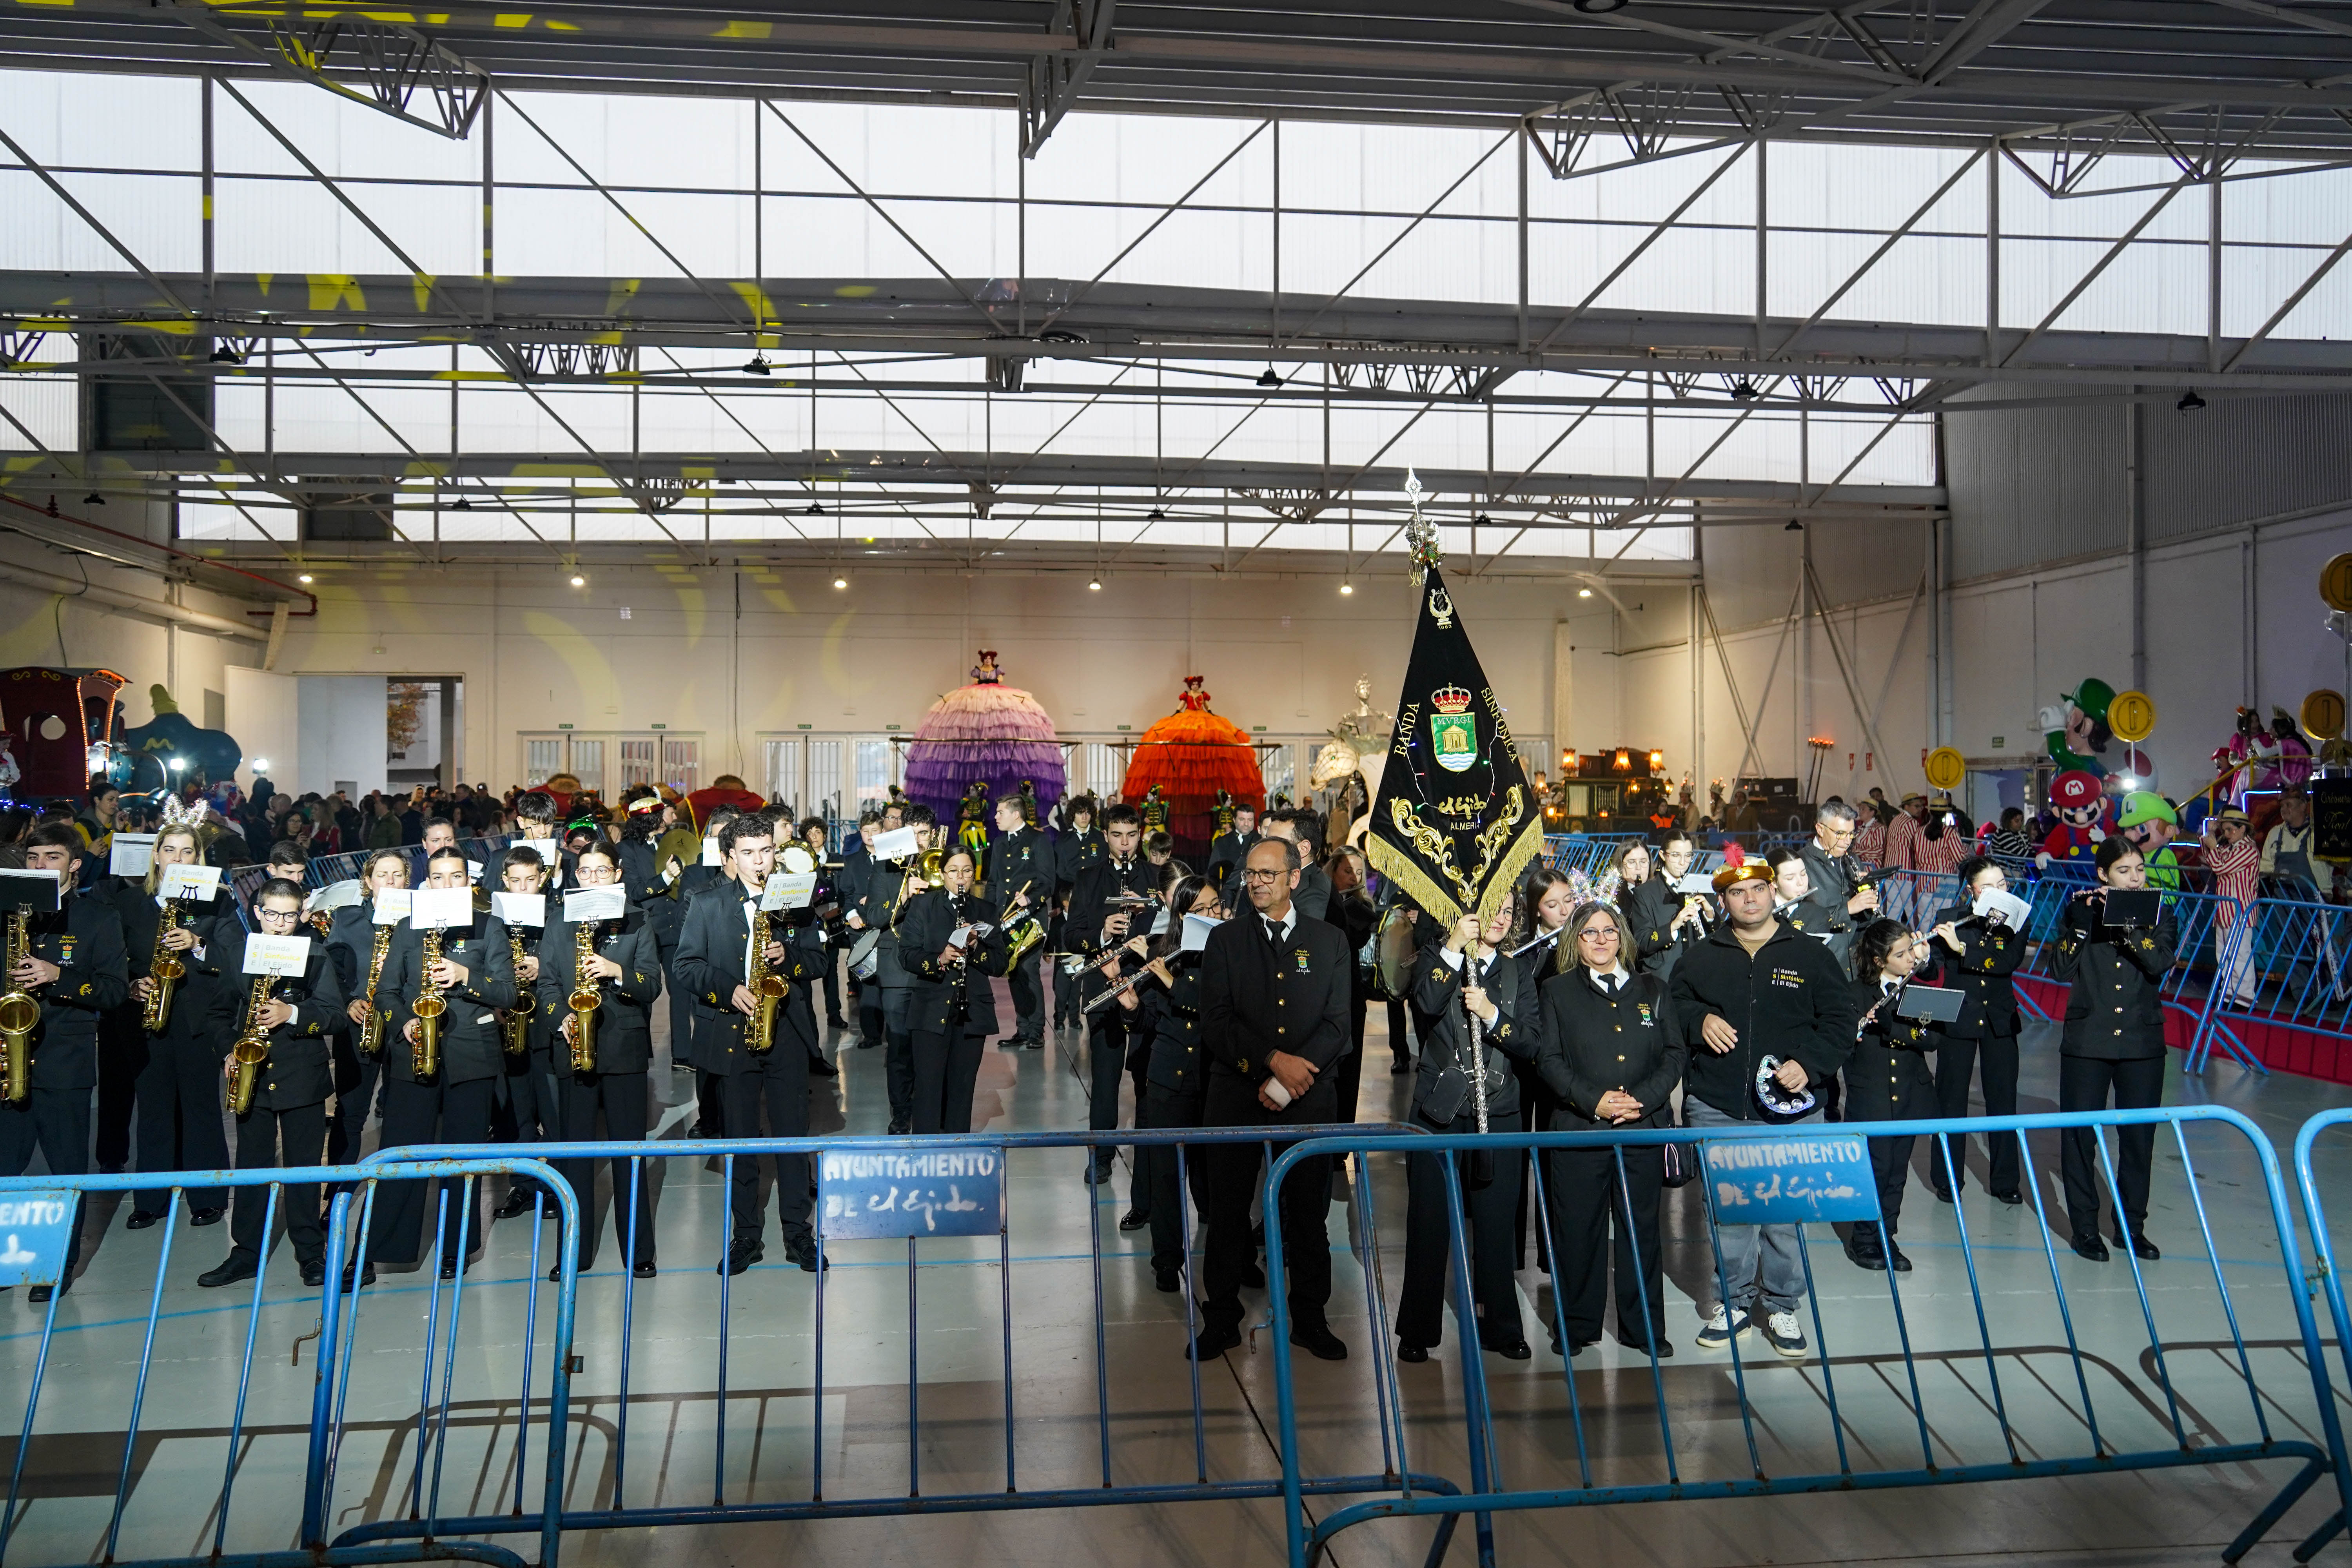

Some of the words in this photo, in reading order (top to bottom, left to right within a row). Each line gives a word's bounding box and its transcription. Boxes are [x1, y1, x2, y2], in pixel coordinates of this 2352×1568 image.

[1437, 716, 1471, 724] MVRGI
[1394, 702, 1420, 757] BANDA
[2069, 782, 2082, 794] M
[2126, 801, 2132, 814] L
[264, 953, 301, 961] Sinfónica
[1780, 974, 1804, 983] Sinfónica
[1708, 1140, 1861, 1170] AYUNTAMIENTO
[824, 1153, 995, 1181] AYUNTAMIENTO
[1717, 1182, 1750, 1206] DE
[825, 1195, 857, 1218] DE
